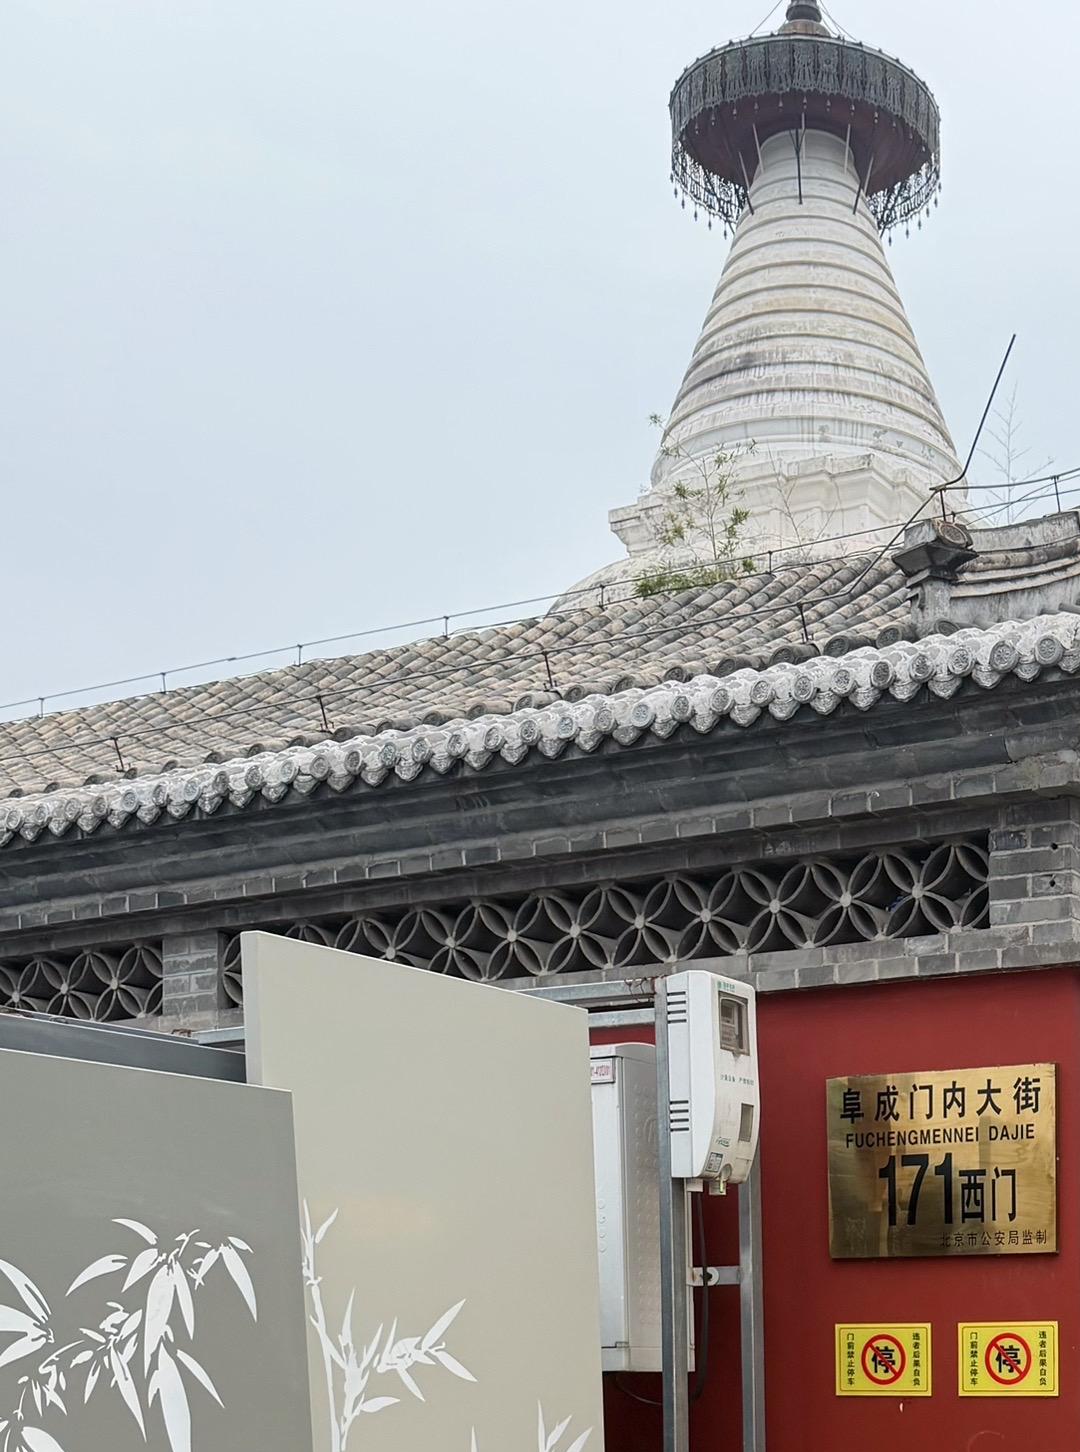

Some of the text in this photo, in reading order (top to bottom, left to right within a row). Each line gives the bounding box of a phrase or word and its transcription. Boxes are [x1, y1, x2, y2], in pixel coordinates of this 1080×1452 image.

[840, 1077, 1041, 1124] 阜成门内大街
[846, 1124, 1035, 1149] FUCHENGMENNEI DAJIE
[878, 1152, 1017, 1226] 171西门
[941, 1230, 1047, 1248] 北京市公安局监制
[847, 1333, 856, 1386] 门前禁止停车
[871, 1346, 896, 1373] 停
[912, 1332, 921, 1386] 违者后果自负
[969, 1331, 978, 1386] 门前禁止停车
[995, 1345, 1021, 1373] 停
[1039, 1331, 1048, 1386] 违者后果自负
